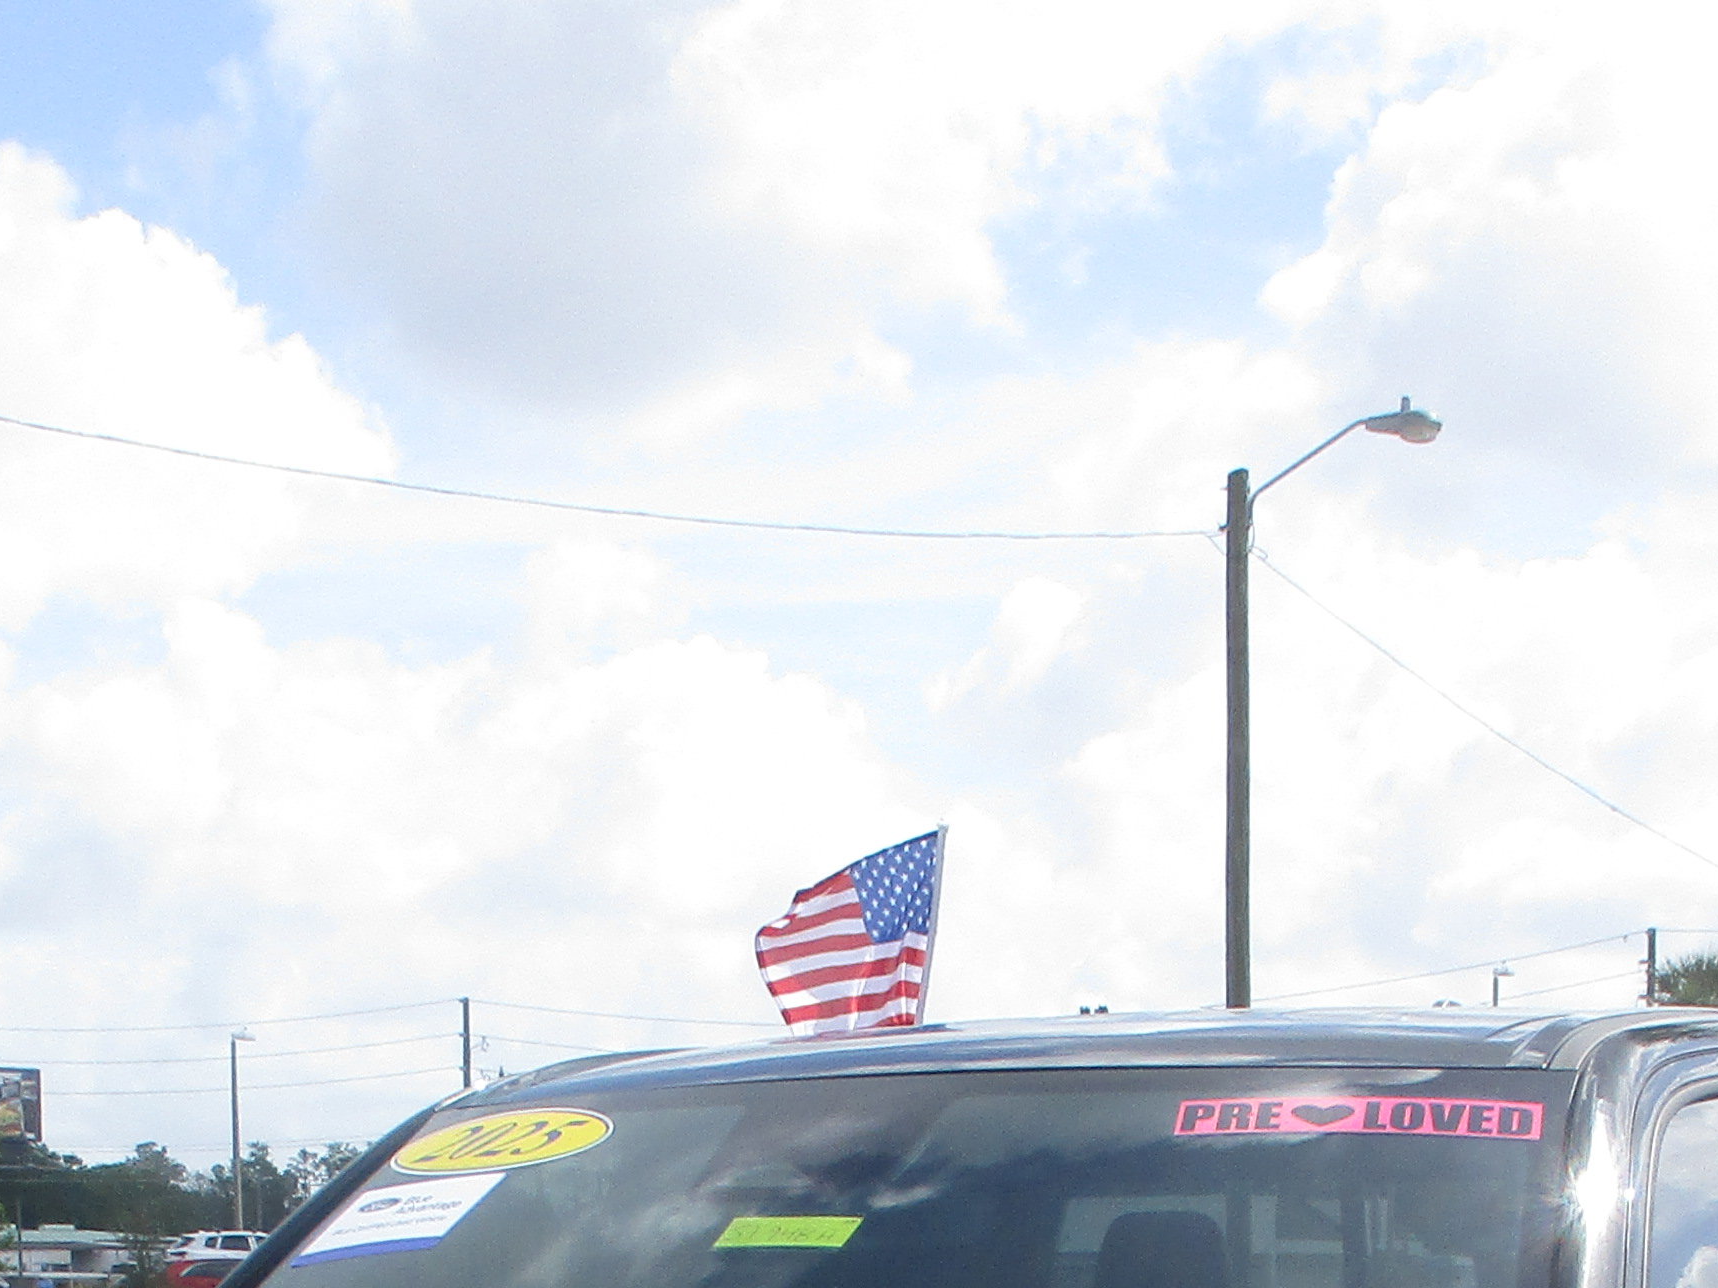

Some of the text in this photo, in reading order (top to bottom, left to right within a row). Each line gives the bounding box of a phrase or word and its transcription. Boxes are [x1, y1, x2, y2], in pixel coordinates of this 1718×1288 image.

[1180, 1101, 1533, 1136] PRE LOVED
[410, 1119, 590, 1164] 2025
